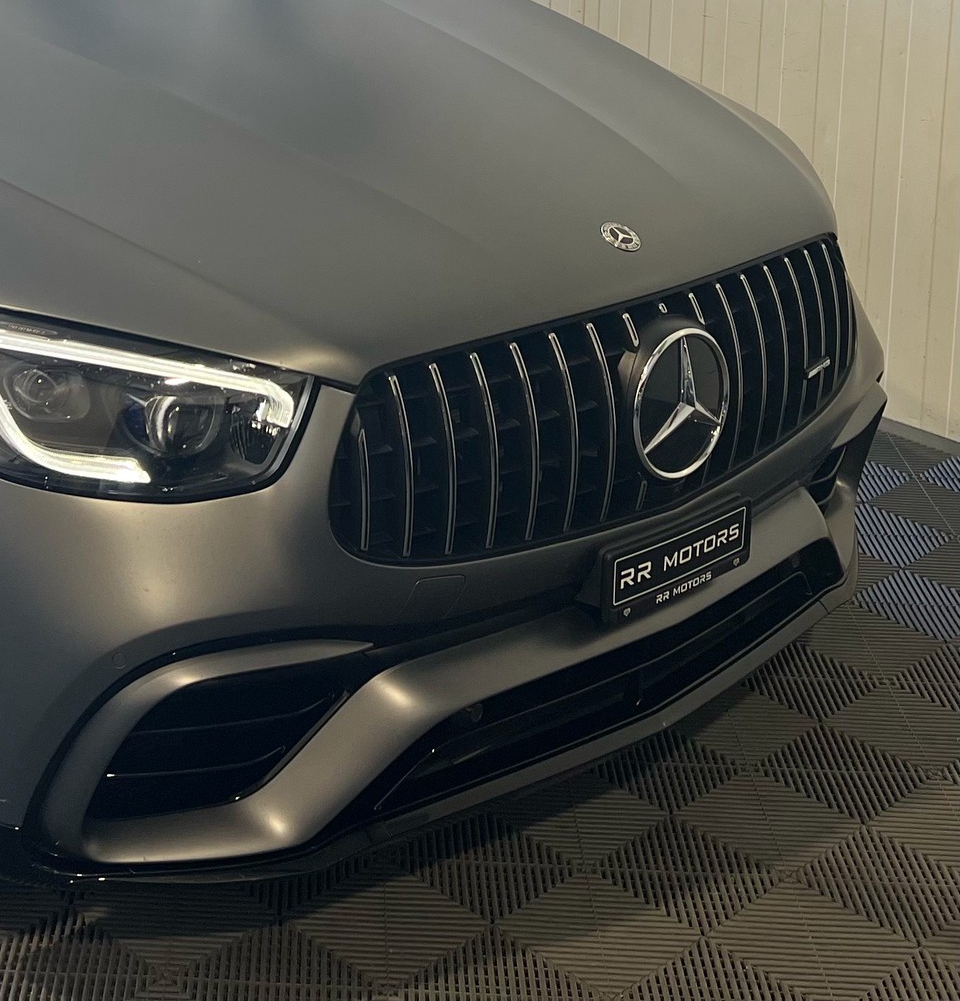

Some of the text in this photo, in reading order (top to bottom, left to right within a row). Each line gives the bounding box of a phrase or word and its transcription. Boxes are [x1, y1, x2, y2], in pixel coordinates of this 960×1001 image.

[620, 523, 740, 590] RR MOTORS
[655, 571, 712, 604] RR MOTORS
